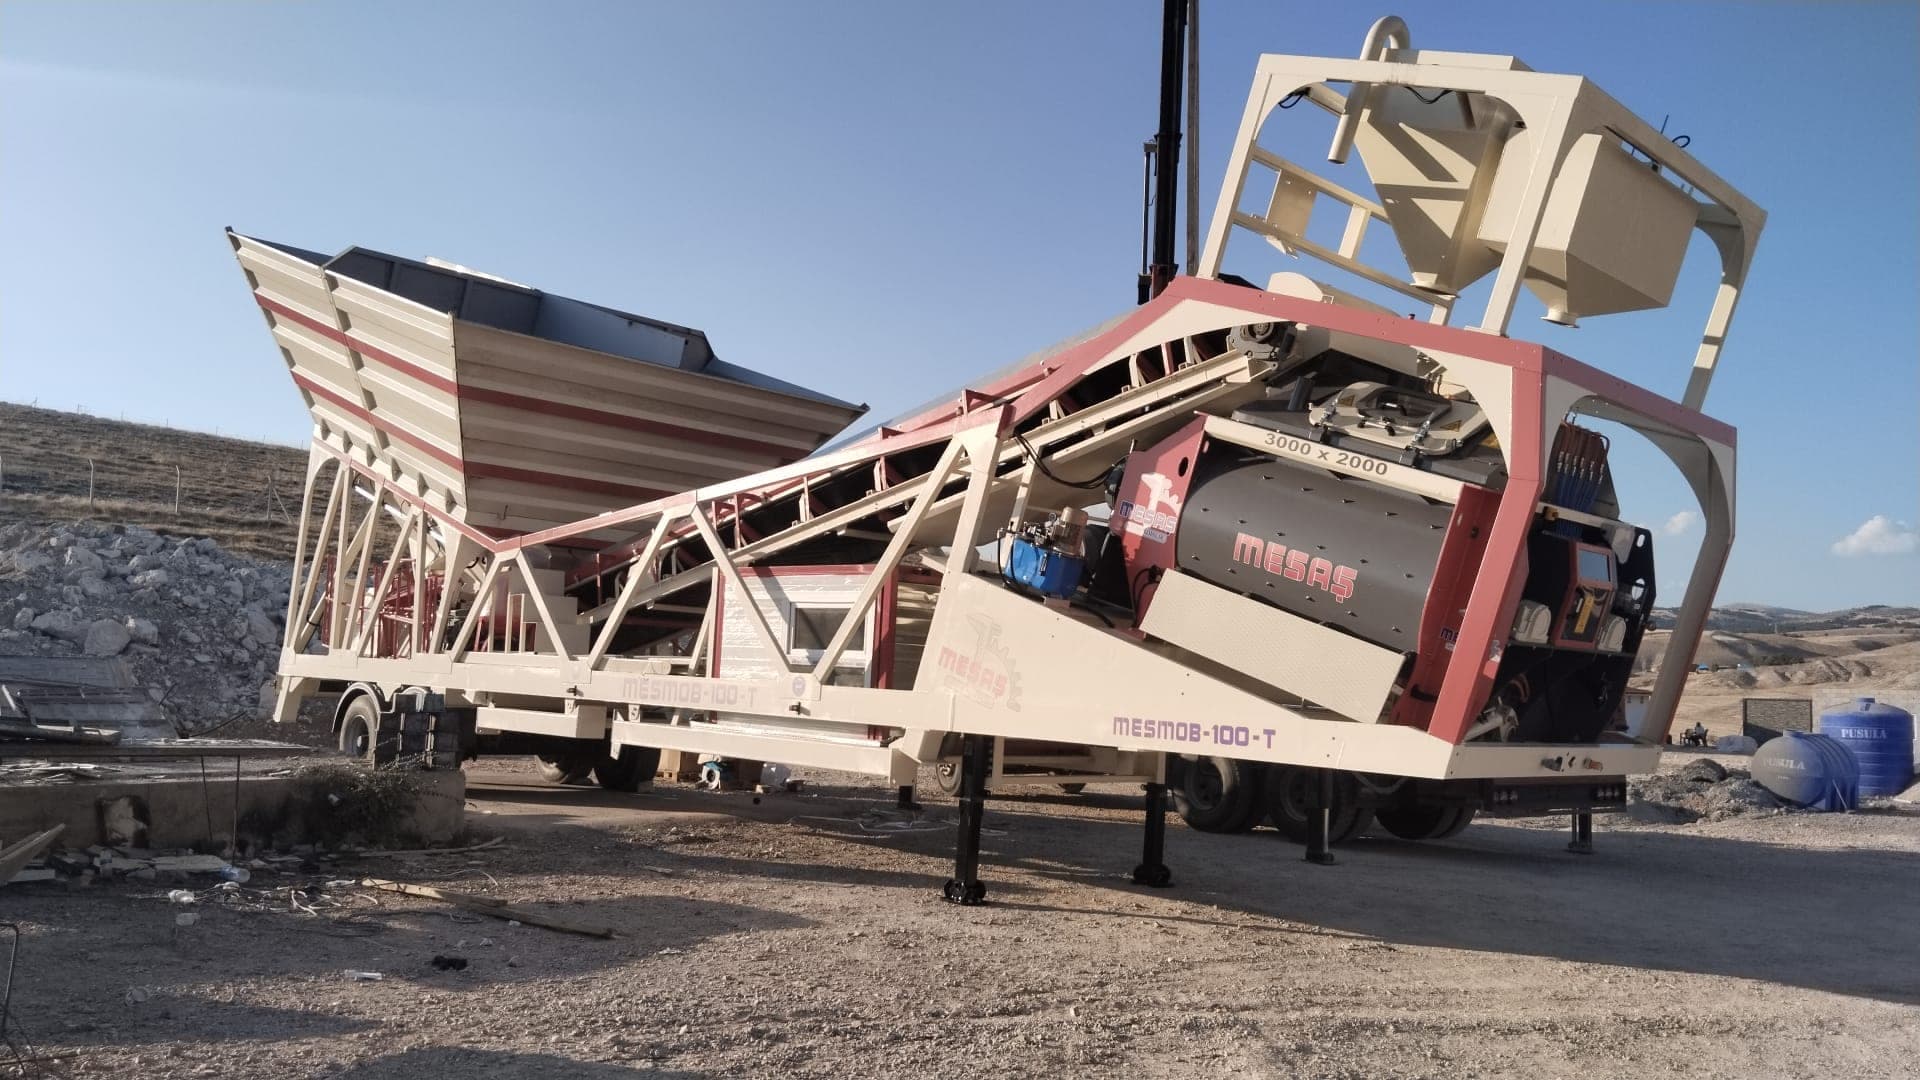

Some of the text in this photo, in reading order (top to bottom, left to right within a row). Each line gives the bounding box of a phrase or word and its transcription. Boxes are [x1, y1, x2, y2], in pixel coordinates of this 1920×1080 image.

[1264, 433, 1311, 455] 3000
[1336, 452, 1388, 475] 2000
[1233, 532, 1358, 603] MESAŞ
[1113, 716, 1277, 749] MESMOB-100-T
[1841, 728, 1888, 739] PUSULA
